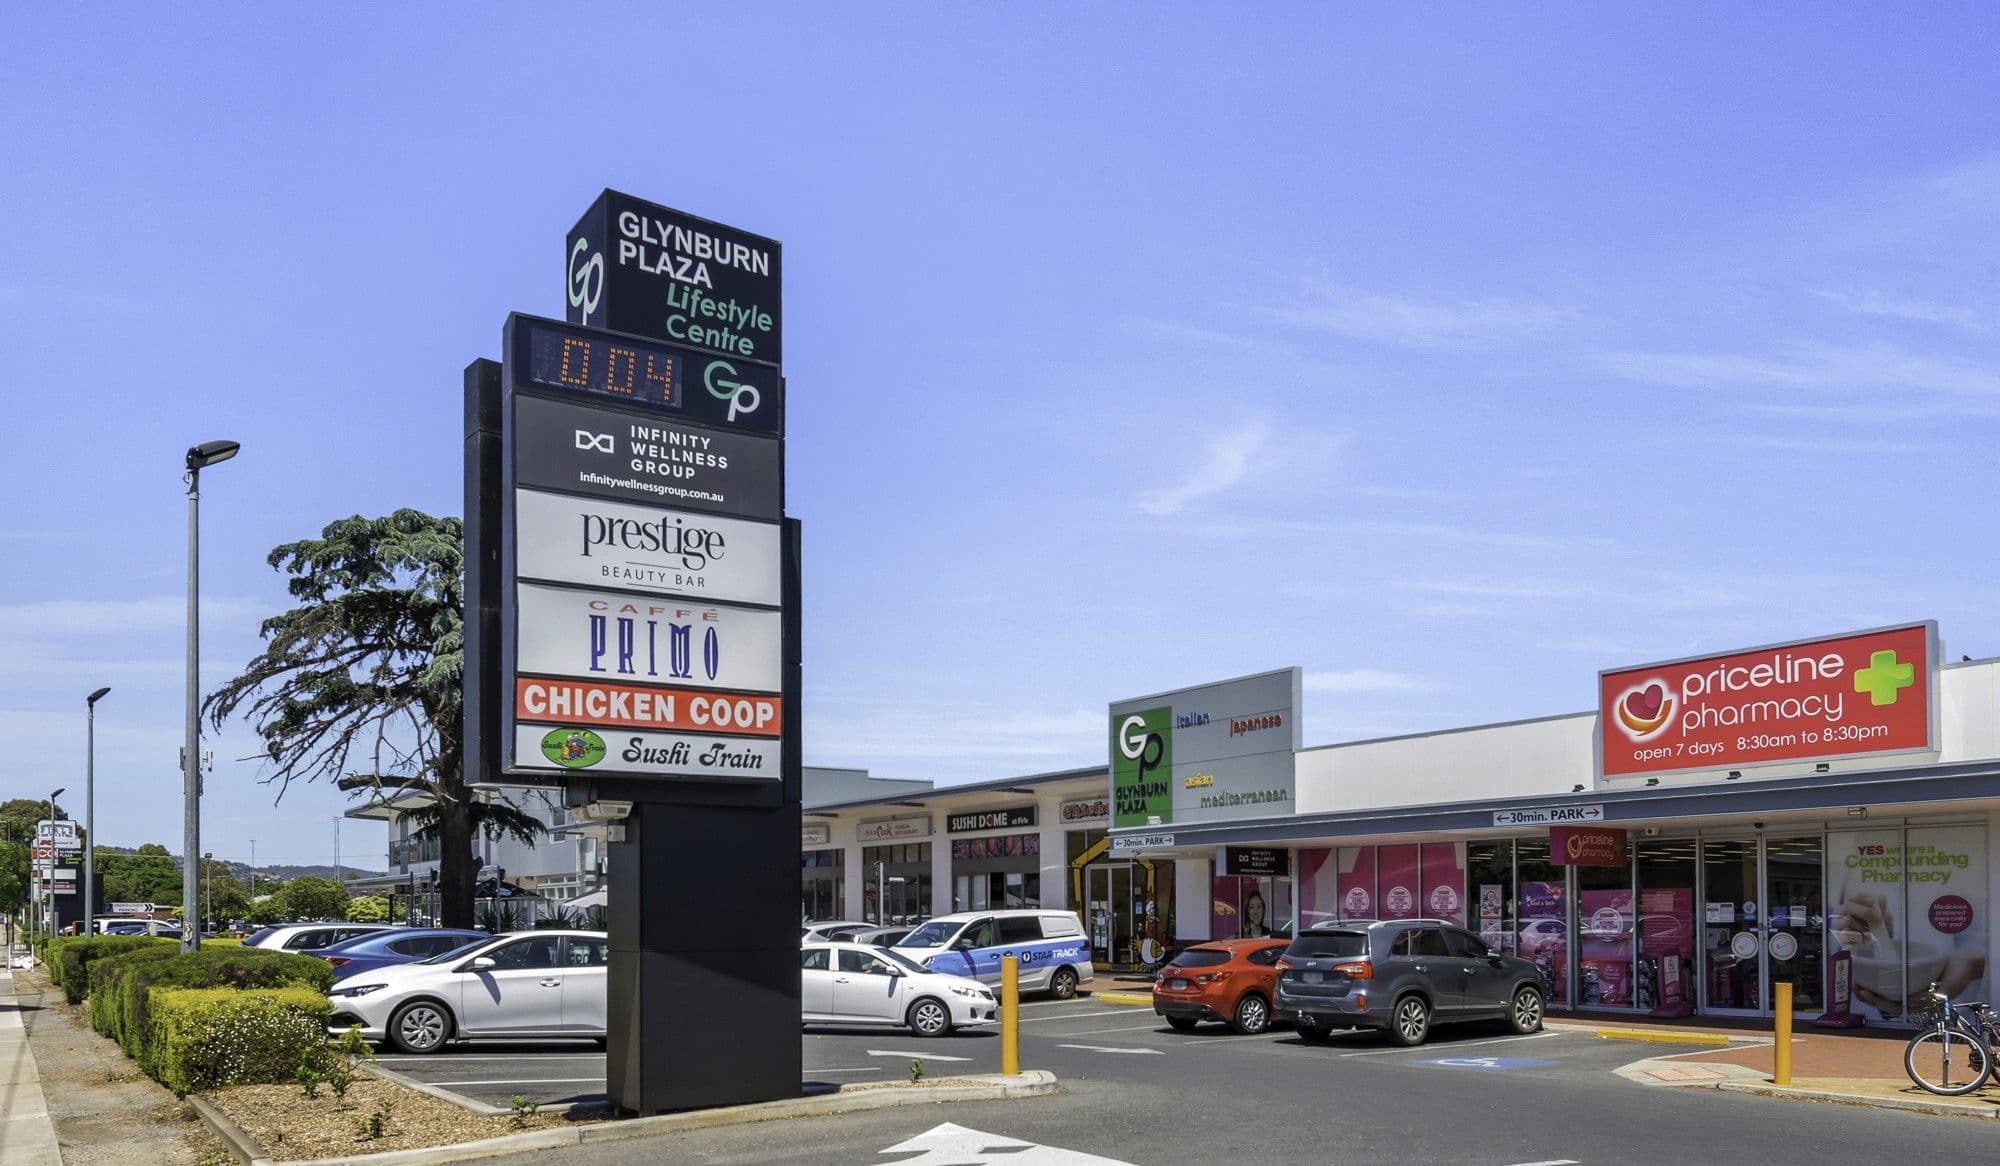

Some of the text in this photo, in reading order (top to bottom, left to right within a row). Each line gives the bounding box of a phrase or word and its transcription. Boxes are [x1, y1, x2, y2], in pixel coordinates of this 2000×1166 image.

[618, 210, 770, 278] GLYNBURN
[619, 239, 713, 290] PLAZA
[666, 283, 774, 333] Lifestyle
[666, 314, 755, 356] Centre
[630, 424, 712, 451] INFINITY
[630, 441, 729, 470] WELLNESS
[630, 458, 697, 480] GROUP
[579, 471, 725, 503] infinitywellnessgroup.com.au
[580, 513, 726, 571] prestige
[601, 565, 706, 588] BEAUTY BAR
[588, 614, 720, 681] PRIMO
[1682, 653, 1845, 706] priceline
[523, 684, 775, 729] CHICKEN COOP
[1682, 692, 1845, 737] pharmacy
[1230, 713, 1283, 738] japanese
[621, 736, 763, 770] Sushi Train
[1633, 723, 1889, 762] open 7 days 8:30am to 8:30pm
[1116, 782, 1168, 799] GLYNBURN
[1184, 774, 1215, 789] asian
[1117, 799, 1147, 815] PLAZA
[1200, 787, 1288, 809] mediterranean
[952, 817, 976, 831] SUSHI
[979, 812, 1008, 828] DOME
[1510, 808, 1585, 823] 30min. PARK
[1145, 836, 1166, 847] PARK
[1857, 845, 1885, 856] YES
